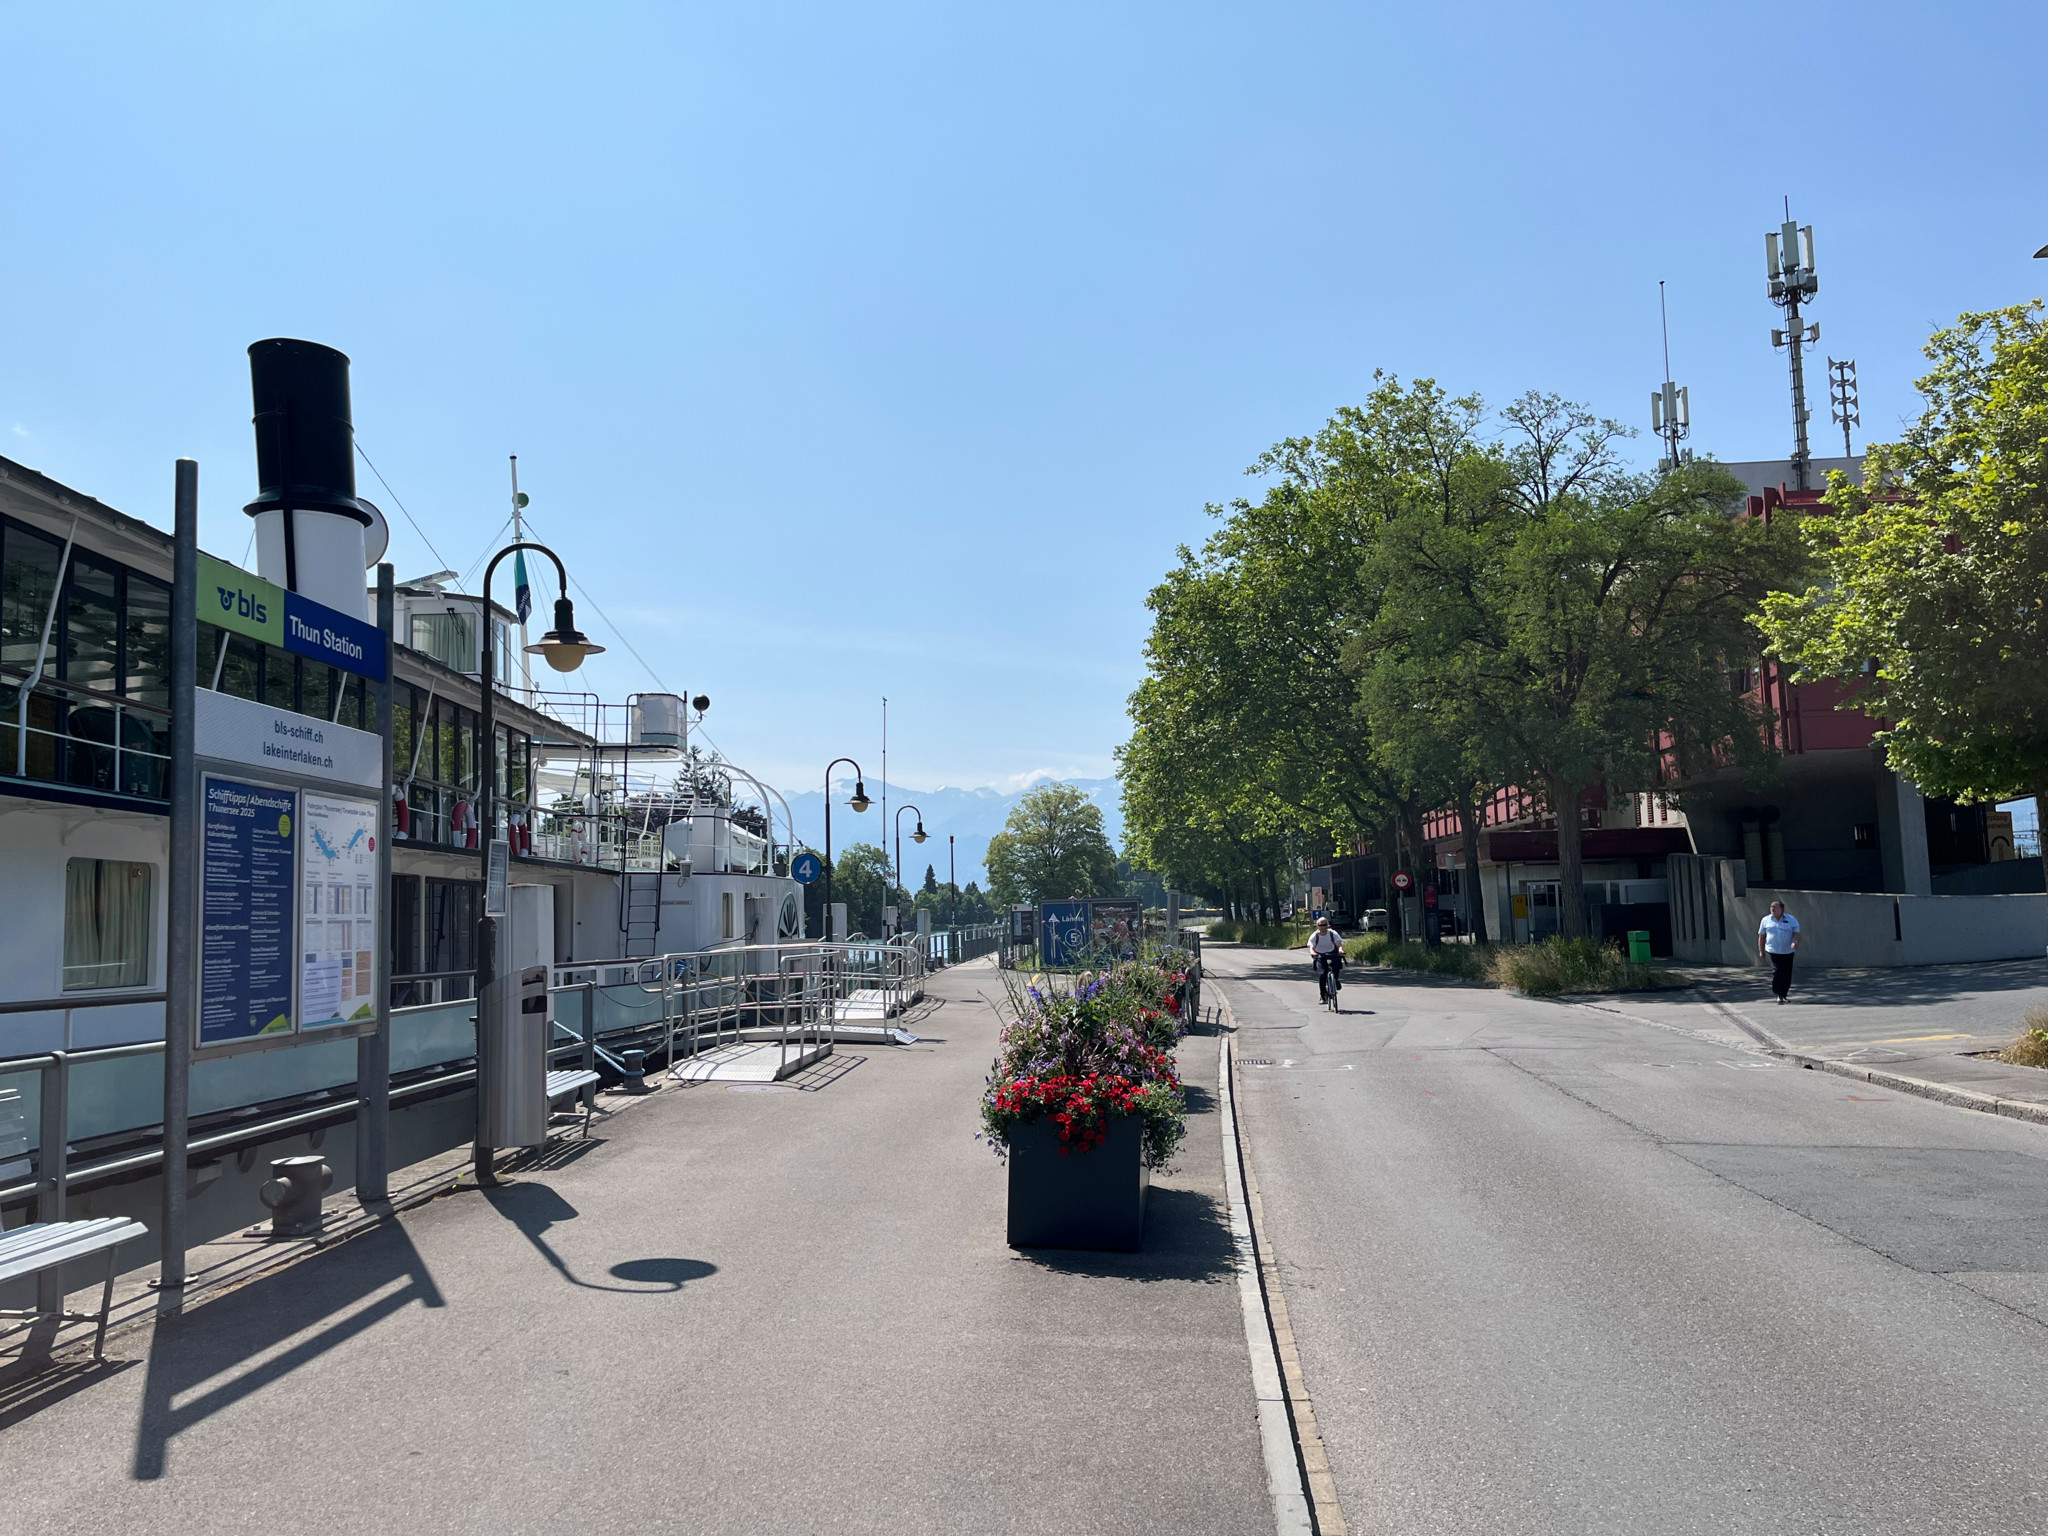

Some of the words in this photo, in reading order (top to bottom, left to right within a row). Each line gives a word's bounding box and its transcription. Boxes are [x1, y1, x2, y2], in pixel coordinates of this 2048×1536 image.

[238, 588, 267, 624] bls
[289, 614, 321, 645] Thun
[323, 628, 363, 660] Station
[274, 720, 324, 745] bls-schiff.ch
[262, 741, 334, 769] lakeinterlaken.ch
[208, 802, 240, 816] Thunersee
[240, 807, 255, 818] 2025
[799, 859, 813, 878] 4
[1070, 932, 1077, 943] 5
